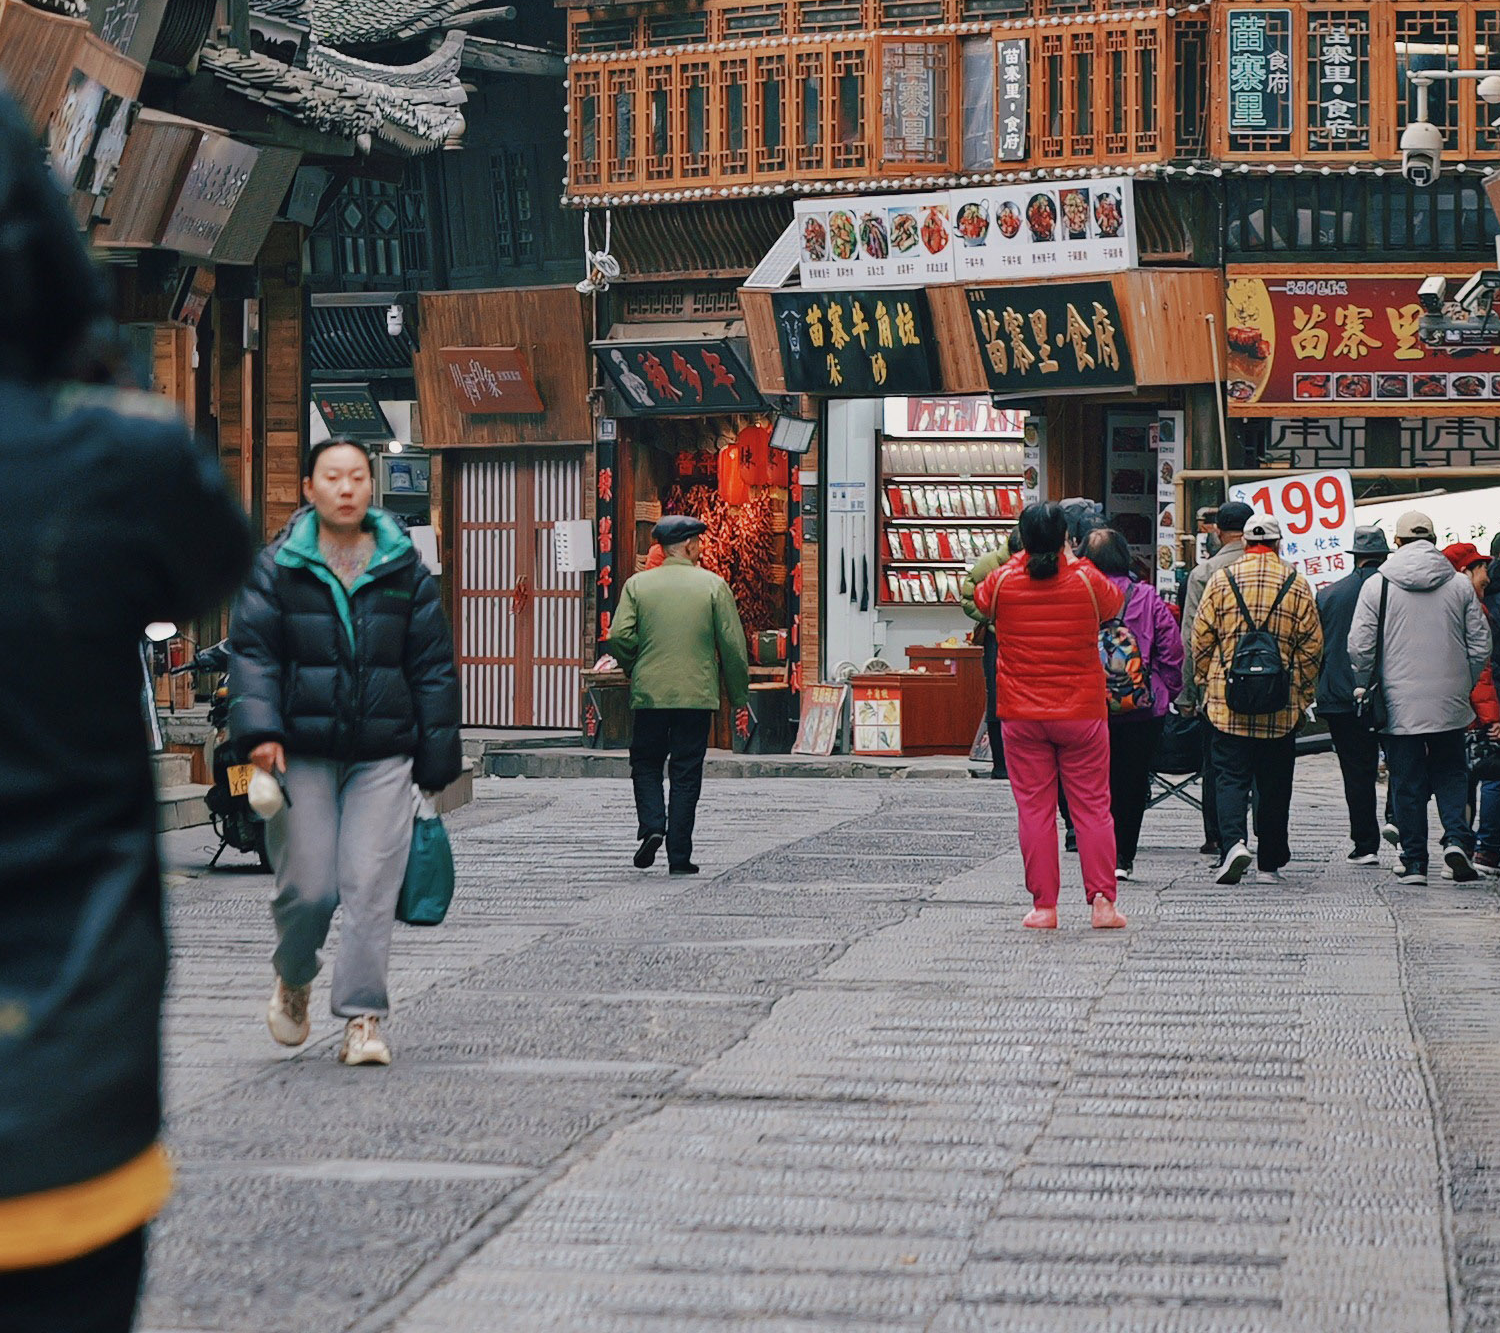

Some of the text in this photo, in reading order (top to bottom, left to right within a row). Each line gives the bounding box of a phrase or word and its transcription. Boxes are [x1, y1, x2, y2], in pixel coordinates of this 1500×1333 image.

[1231, 15, 1266, 127] 苗寨里
[1266, 49, 1289, 96] 食府
[805, 300, 921, 350] 苗寨牛角梳
[1251, 475, 1347, 535] 199
[1280, 536, 1341, 557] 修、化妆
